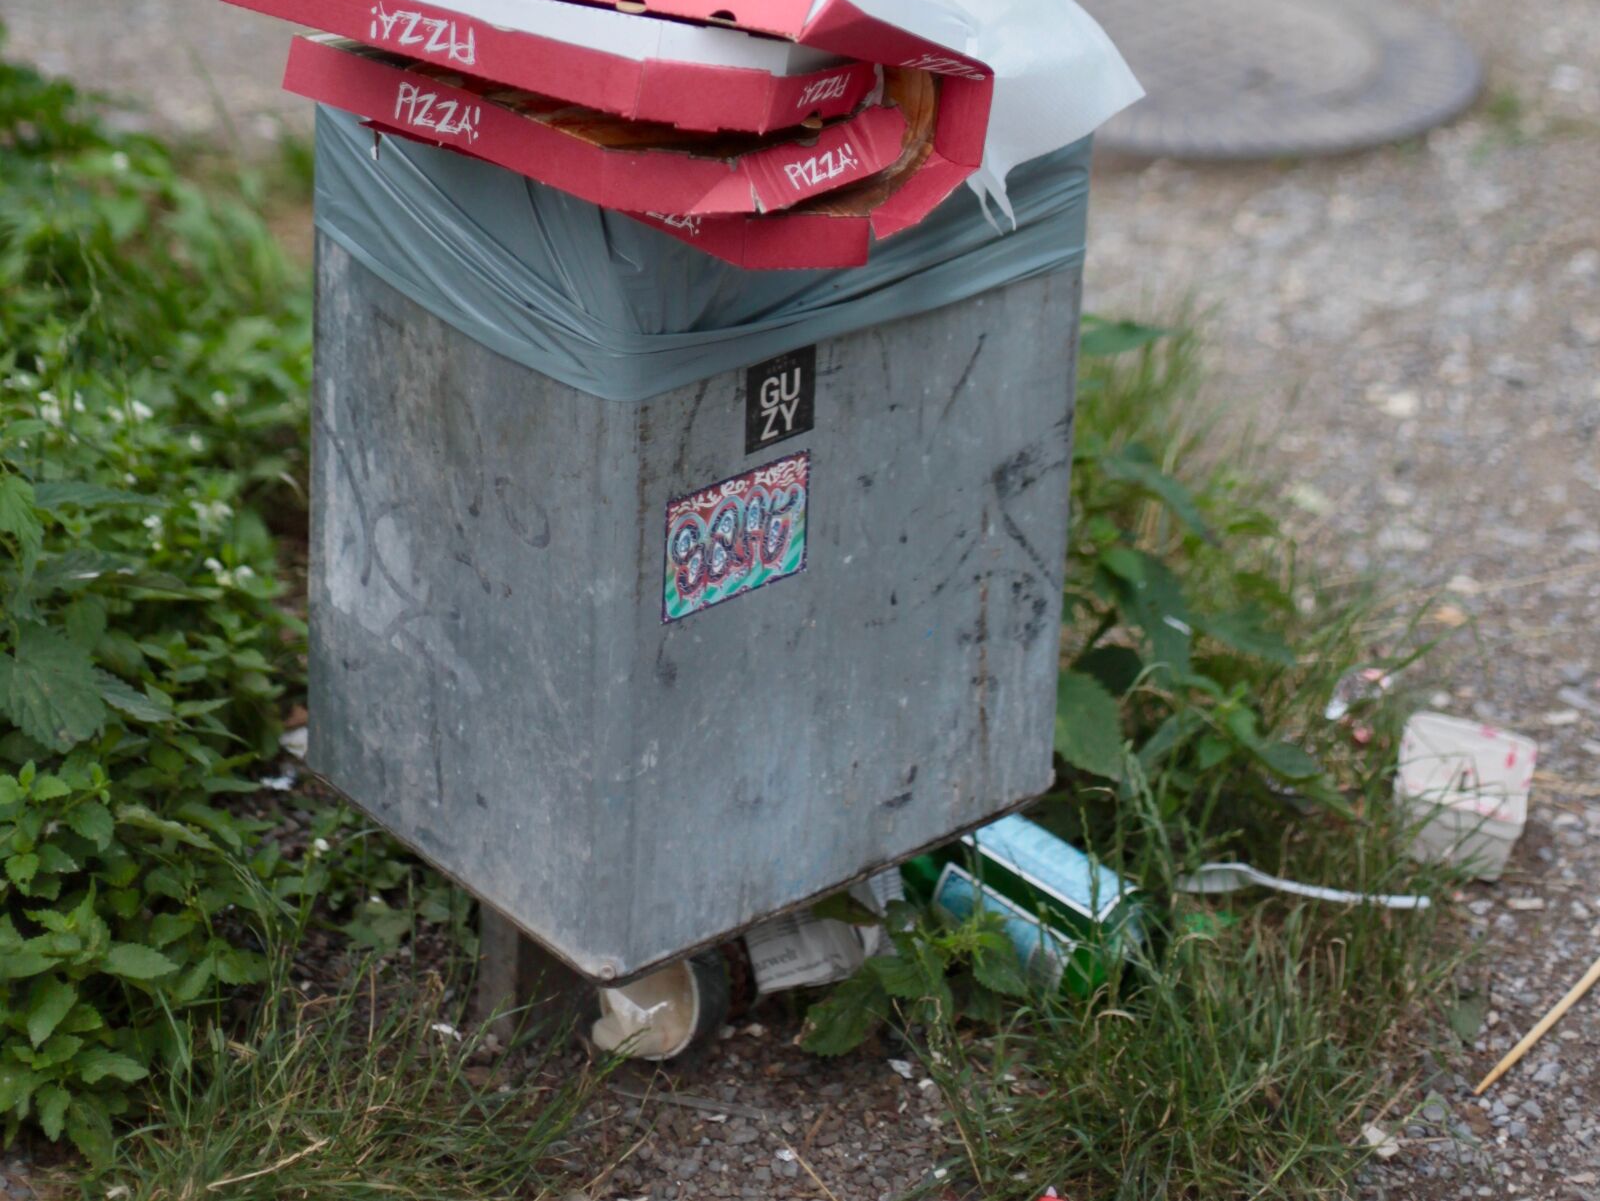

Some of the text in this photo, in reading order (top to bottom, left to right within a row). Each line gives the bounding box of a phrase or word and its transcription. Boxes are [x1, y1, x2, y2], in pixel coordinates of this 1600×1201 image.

[370, 1, 476, 65] PIZZA!
[394, 81, 481, 144] PIZZA!
[797, 72, 851, 108] PIZZA!
[784, 143, 858, 190] PIZZA!
[760, 367, 801, 409] GU
[760, 397, 800, 441] ZY
